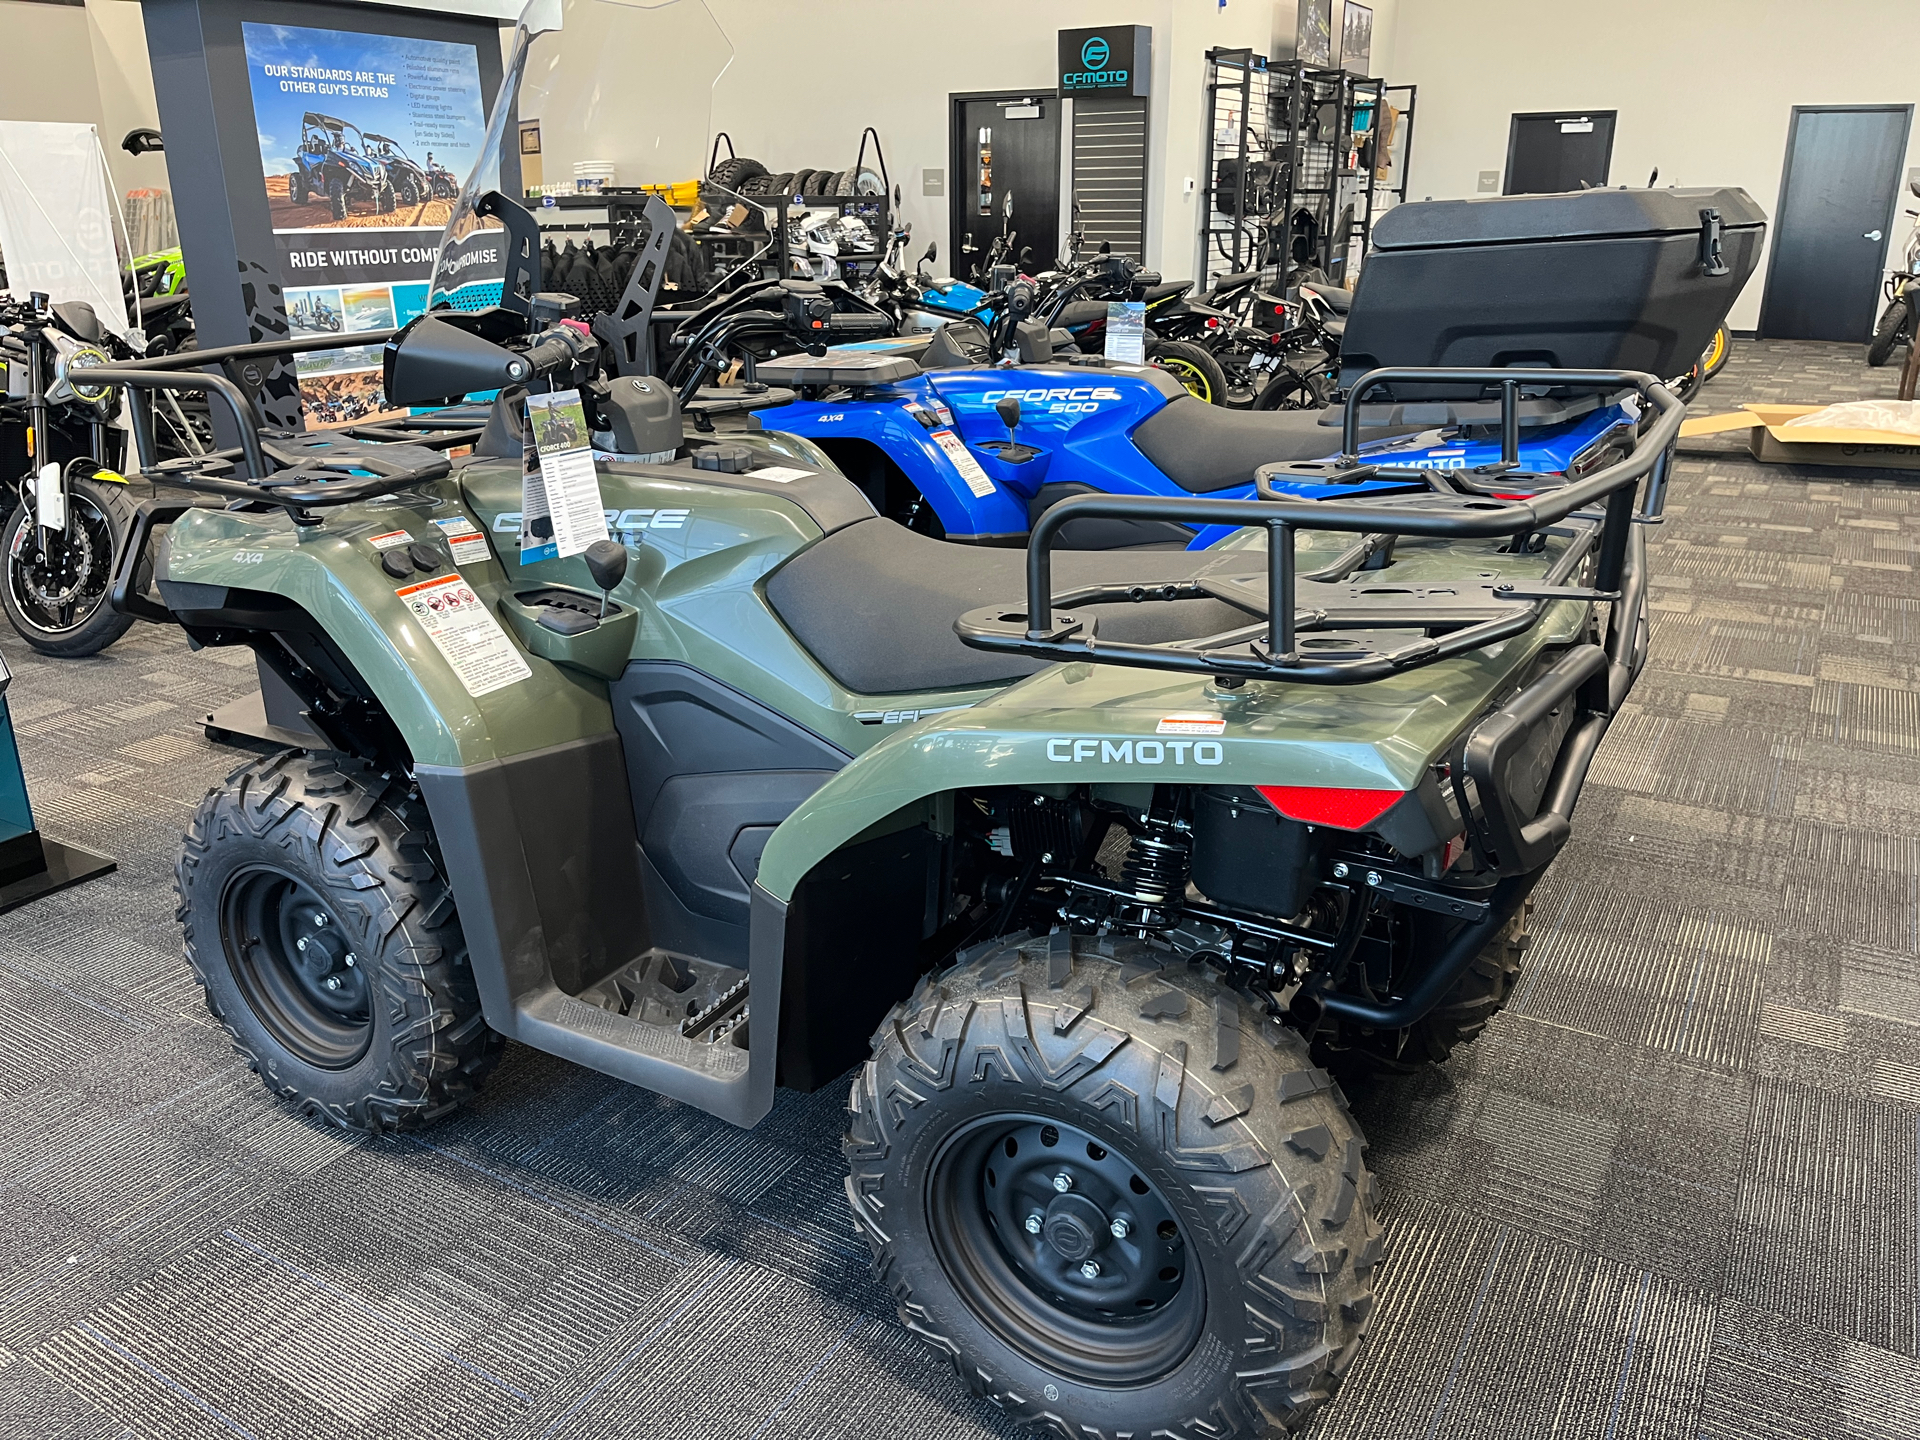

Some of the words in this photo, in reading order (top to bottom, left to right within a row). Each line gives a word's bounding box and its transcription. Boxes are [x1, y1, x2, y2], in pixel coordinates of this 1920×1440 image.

[264, 64, 289, 77] OUR
[290, 66, 353, 82] STANDARDS
[355, 71, 376, 84] ARE
[376, 72, 397, 85] THE
[407, 73, 428, 81] Powerful
[1063, 70, 1128, 85] CFMOTO
[279, 80, 317, 94] OTHER
[318, 82, 349, 96] GUY'S
[350, 85, 389, 99] EXTRAS
[408, 82, 432, 91] Electronic
[290, 250, 329, 269] RIDE
[330, 248, 398, 268] WITHOUT
[982, 387, 1117, 404] CFORCE
[1048, 402, 1100, 414] 500
[540, 443, 561, 453] CFORCE
[560, 441, 571, 449] 400
[883, 709, 920, 724] EFI
[1046, 739, 1224, 766] CFMOTO
